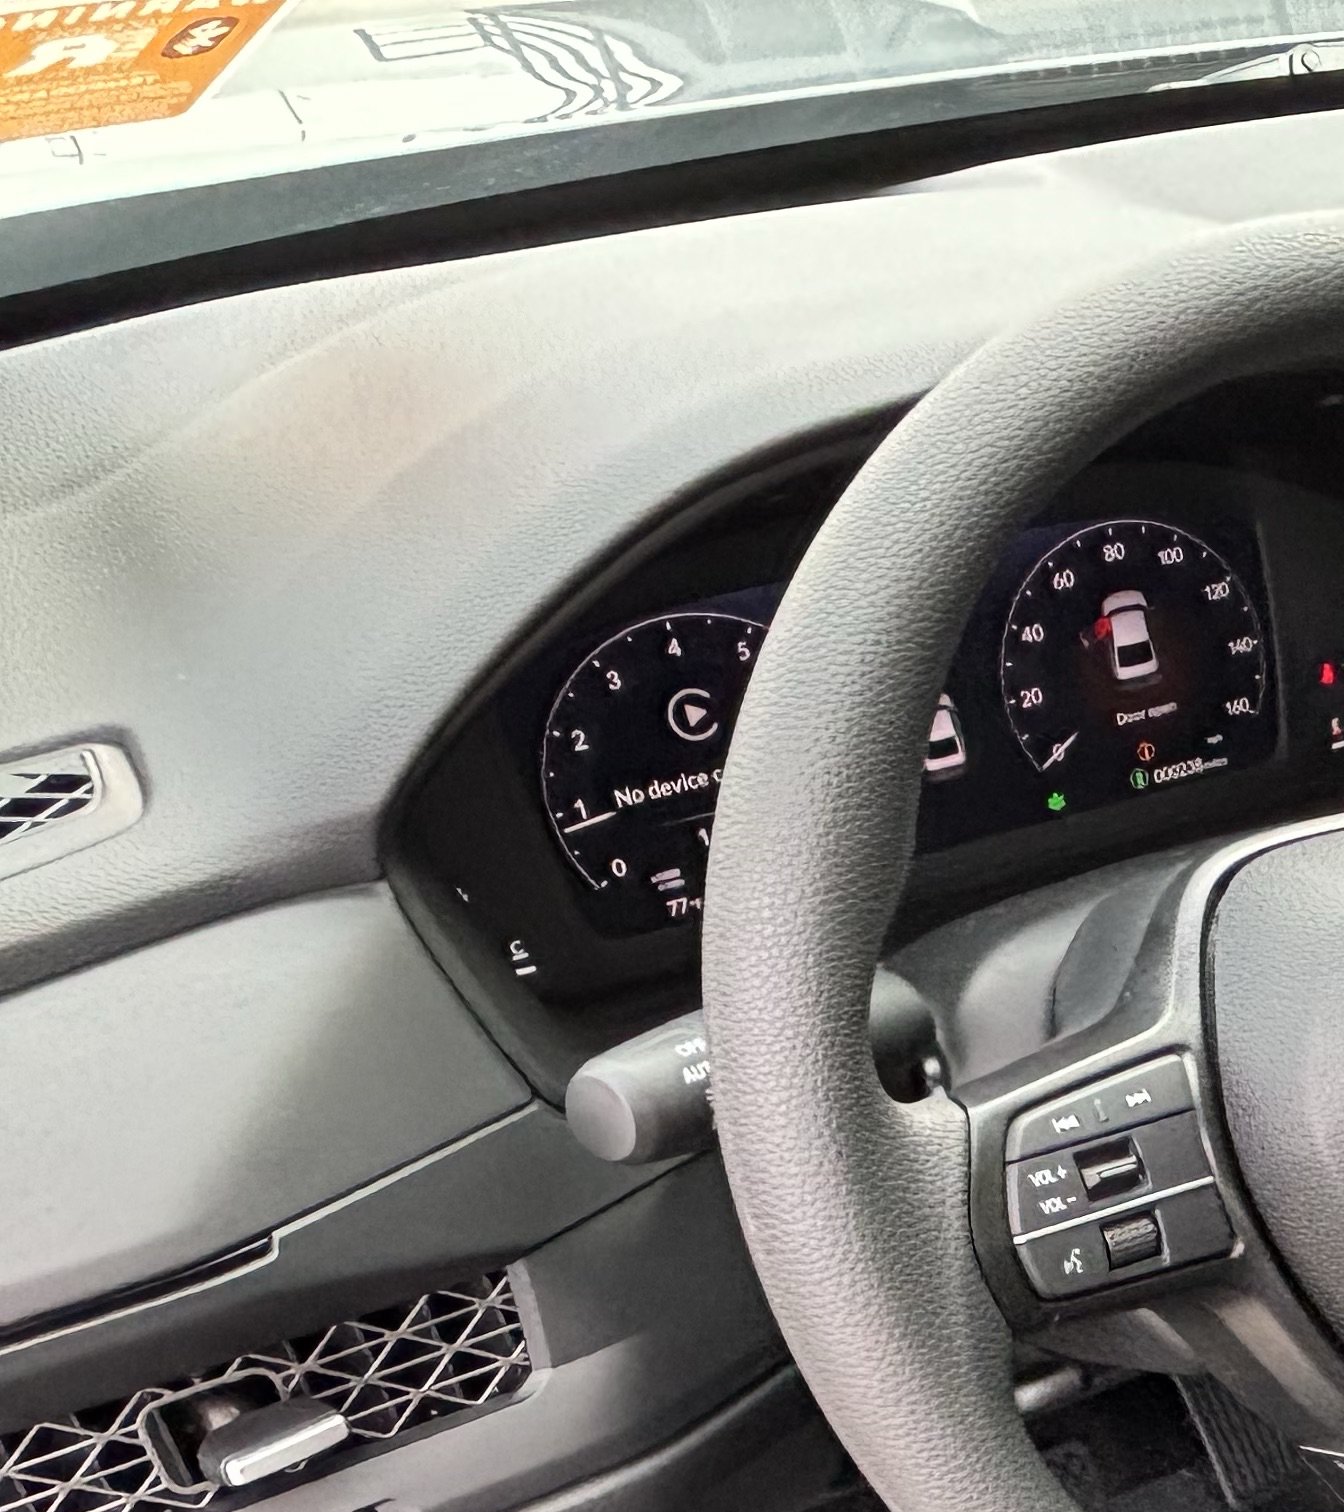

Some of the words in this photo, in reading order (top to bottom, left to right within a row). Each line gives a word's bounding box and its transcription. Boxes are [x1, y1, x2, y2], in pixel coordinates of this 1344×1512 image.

[1103, 541, 1126, 562] 80
[1157, 547, 1184, 566] 100
[1052, 570, 1075, 590] 60
[1204, 581, 1230, 601] 120
[1021, 624, 1044, 642] 40
[666, 638, 682, 657] 4
[737, 641, 751, 661] 5
[1228, 636, 1253, 656] 140
[606, 669, 622, 690] 3
[1020, 687, 1044, 708] 20
[1225, 697, 1251, 716] 160
[570, 730, 590, 752] 2
[614, 785, 645, 809] No
[648, 770, 709, 801] device
[573, 798, 588, 820] 1
[611, 857, 628, 878] 0
[682, 1060, 711, 1085] AUT
